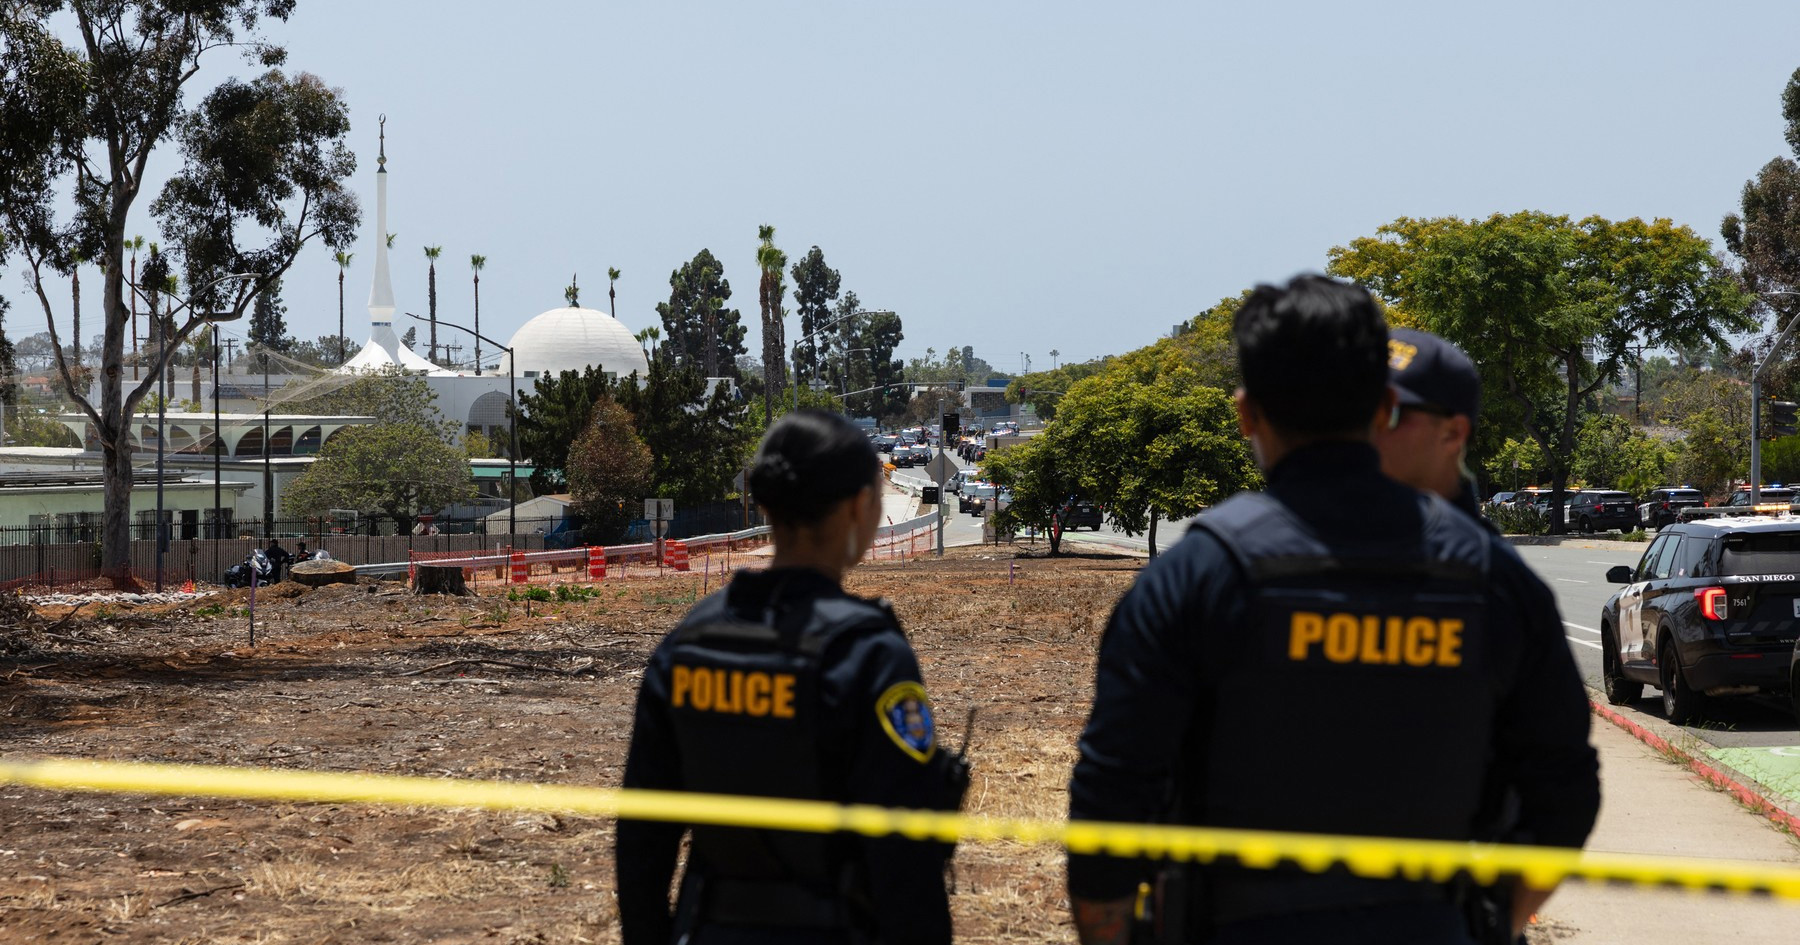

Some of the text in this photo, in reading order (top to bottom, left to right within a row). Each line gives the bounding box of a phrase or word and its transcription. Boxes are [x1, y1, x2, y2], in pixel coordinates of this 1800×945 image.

[1739, 575, 1760, 583] SAN
[1733, 598, 1747, 607] 7561
[1288, 611, 1464, 667] POLICE
[671, 664, 797, 719] POLICE
